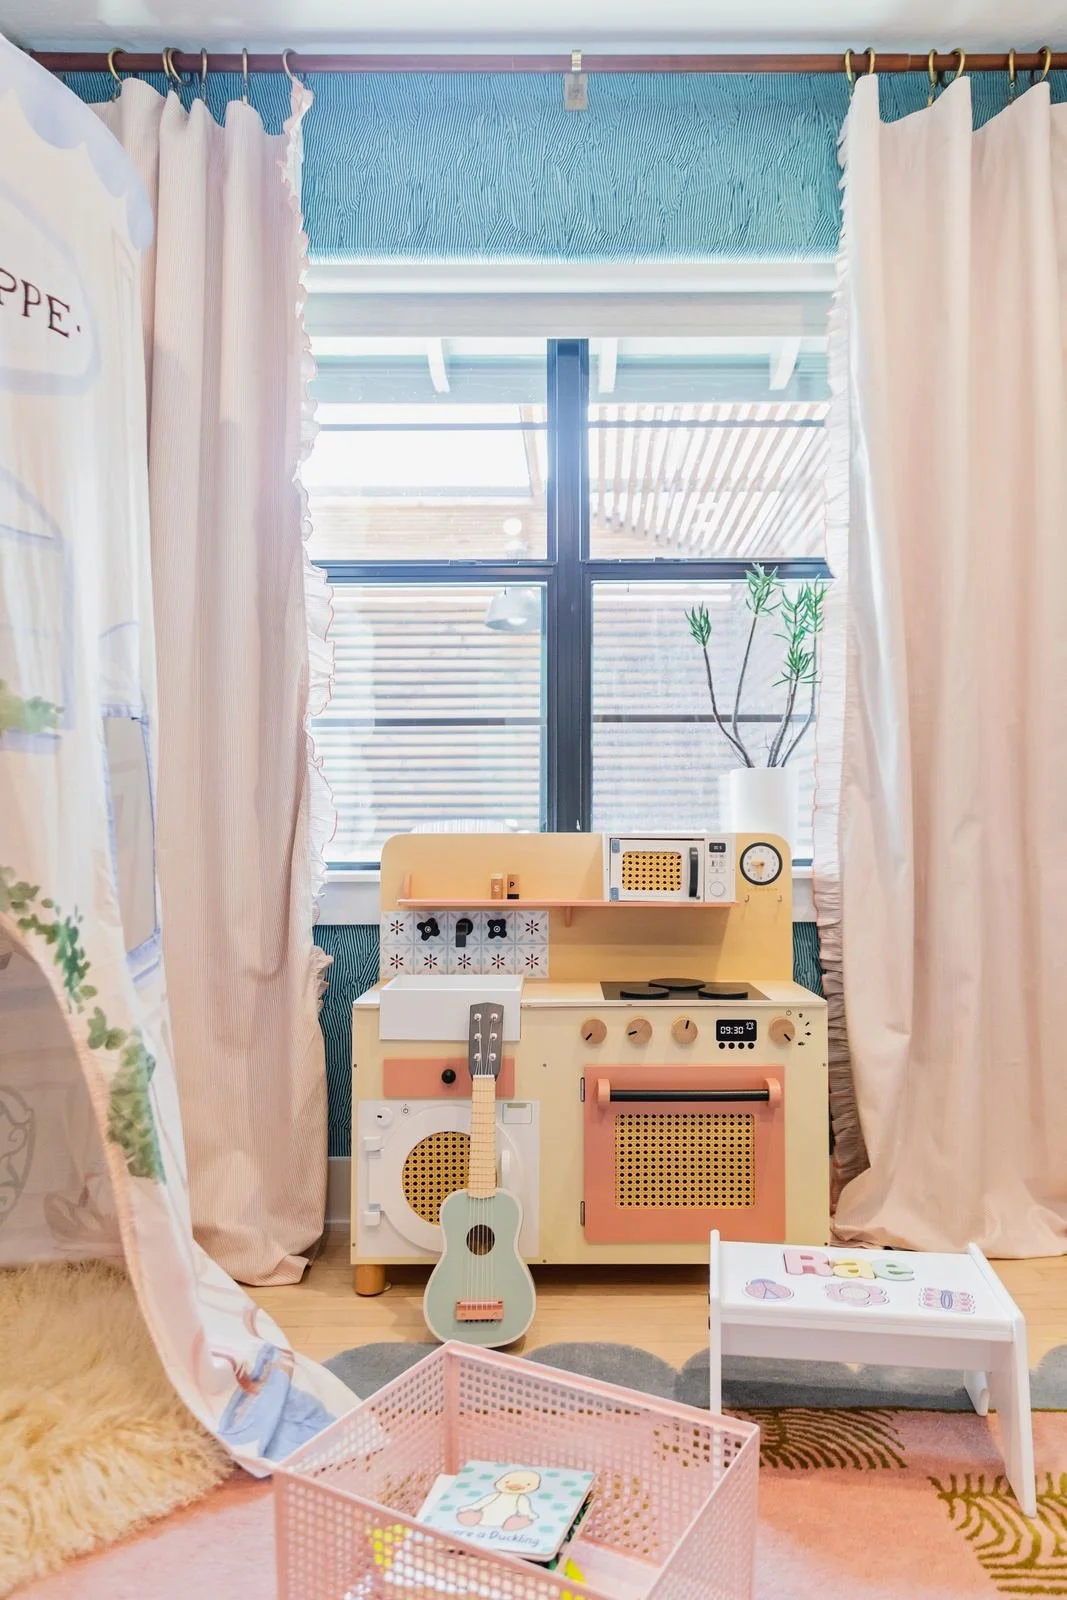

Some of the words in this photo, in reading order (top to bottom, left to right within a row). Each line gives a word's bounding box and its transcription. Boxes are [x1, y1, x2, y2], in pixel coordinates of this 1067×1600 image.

[720, 1026, 744, 1035] 09:30
[783, 1249, 916, 1281] Rae
[488, 1530, 541, 1548] Duckling
